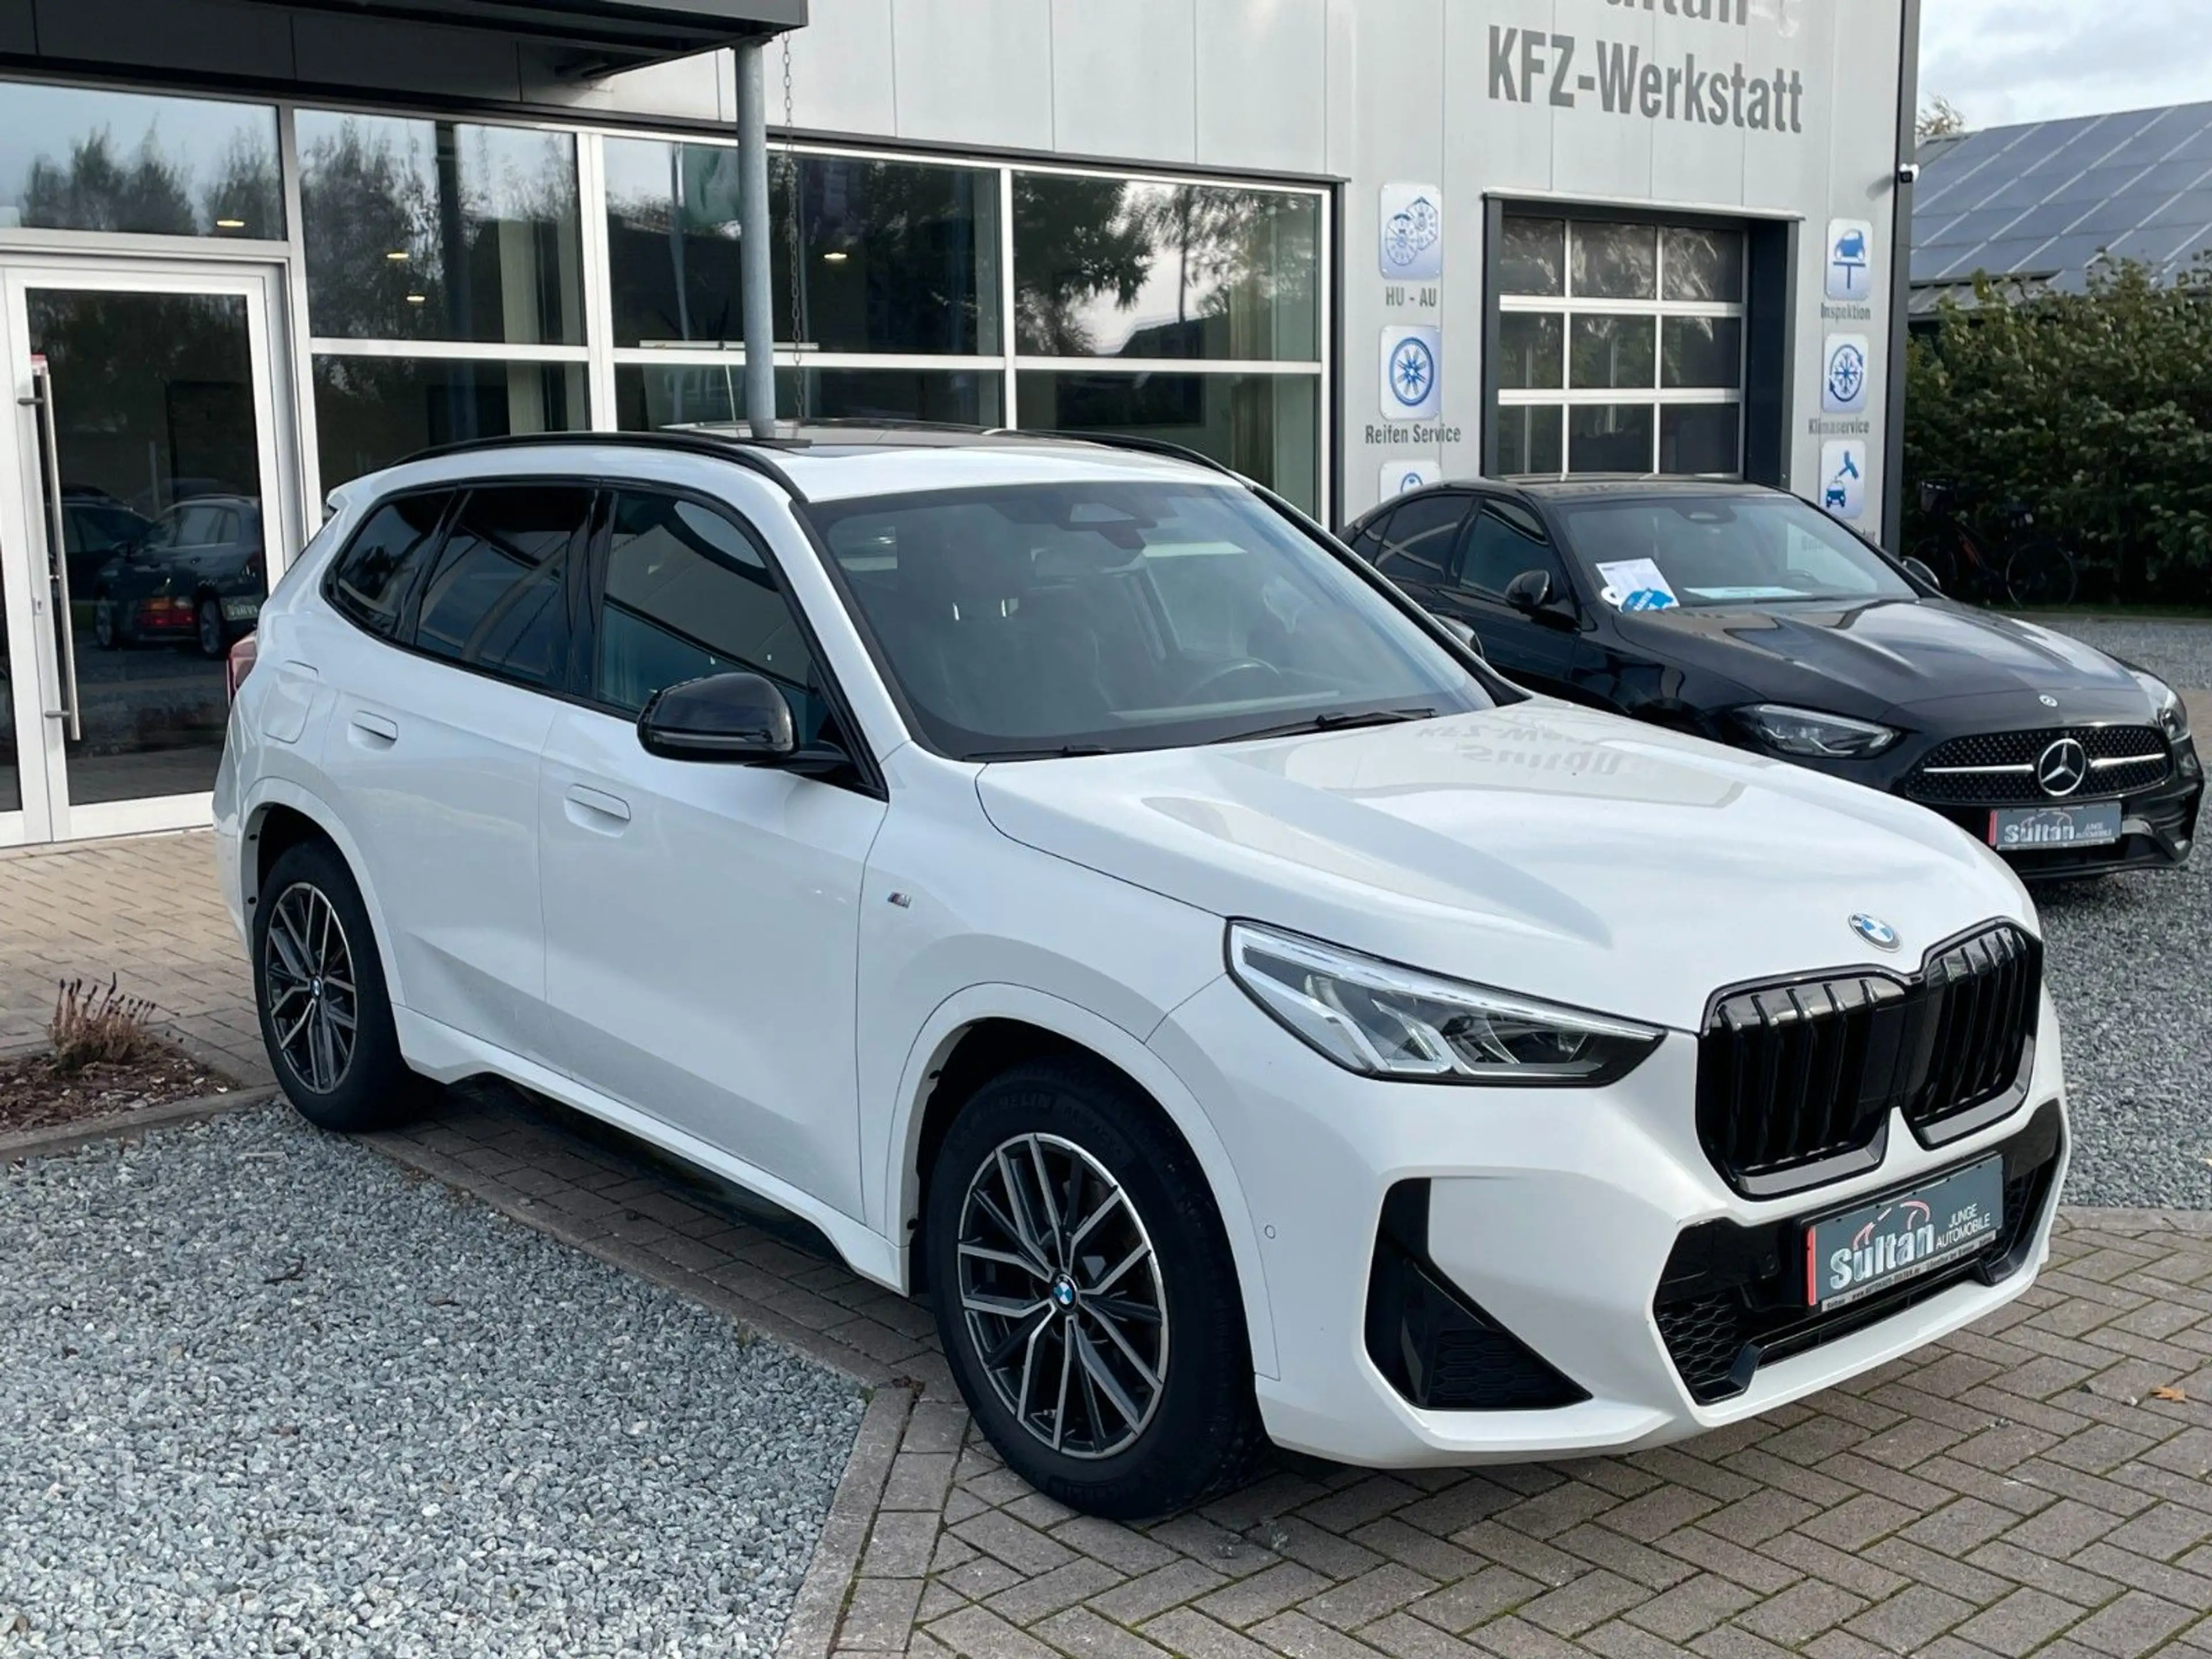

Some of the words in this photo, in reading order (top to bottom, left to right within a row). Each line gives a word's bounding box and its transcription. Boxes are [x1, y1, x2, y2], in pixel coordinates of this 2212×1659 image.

[1488, 24, 1803, 134] KFZ-Werkstatt
[1385, 286, 1404, 306] HU
[1419, 287, 1437, 307] AU
[1365, 424, 1409, 444] Reifen
[1413, 423, 1461, 443] Service
[2003, 823, 2075, 843] Sultan
[1949, 1203, 1978, 1228] JUNGE
[1935, 1213, 1991, 1251] AUTOMOBILE
[1830, 1224, 1935, 1290] Sultan
